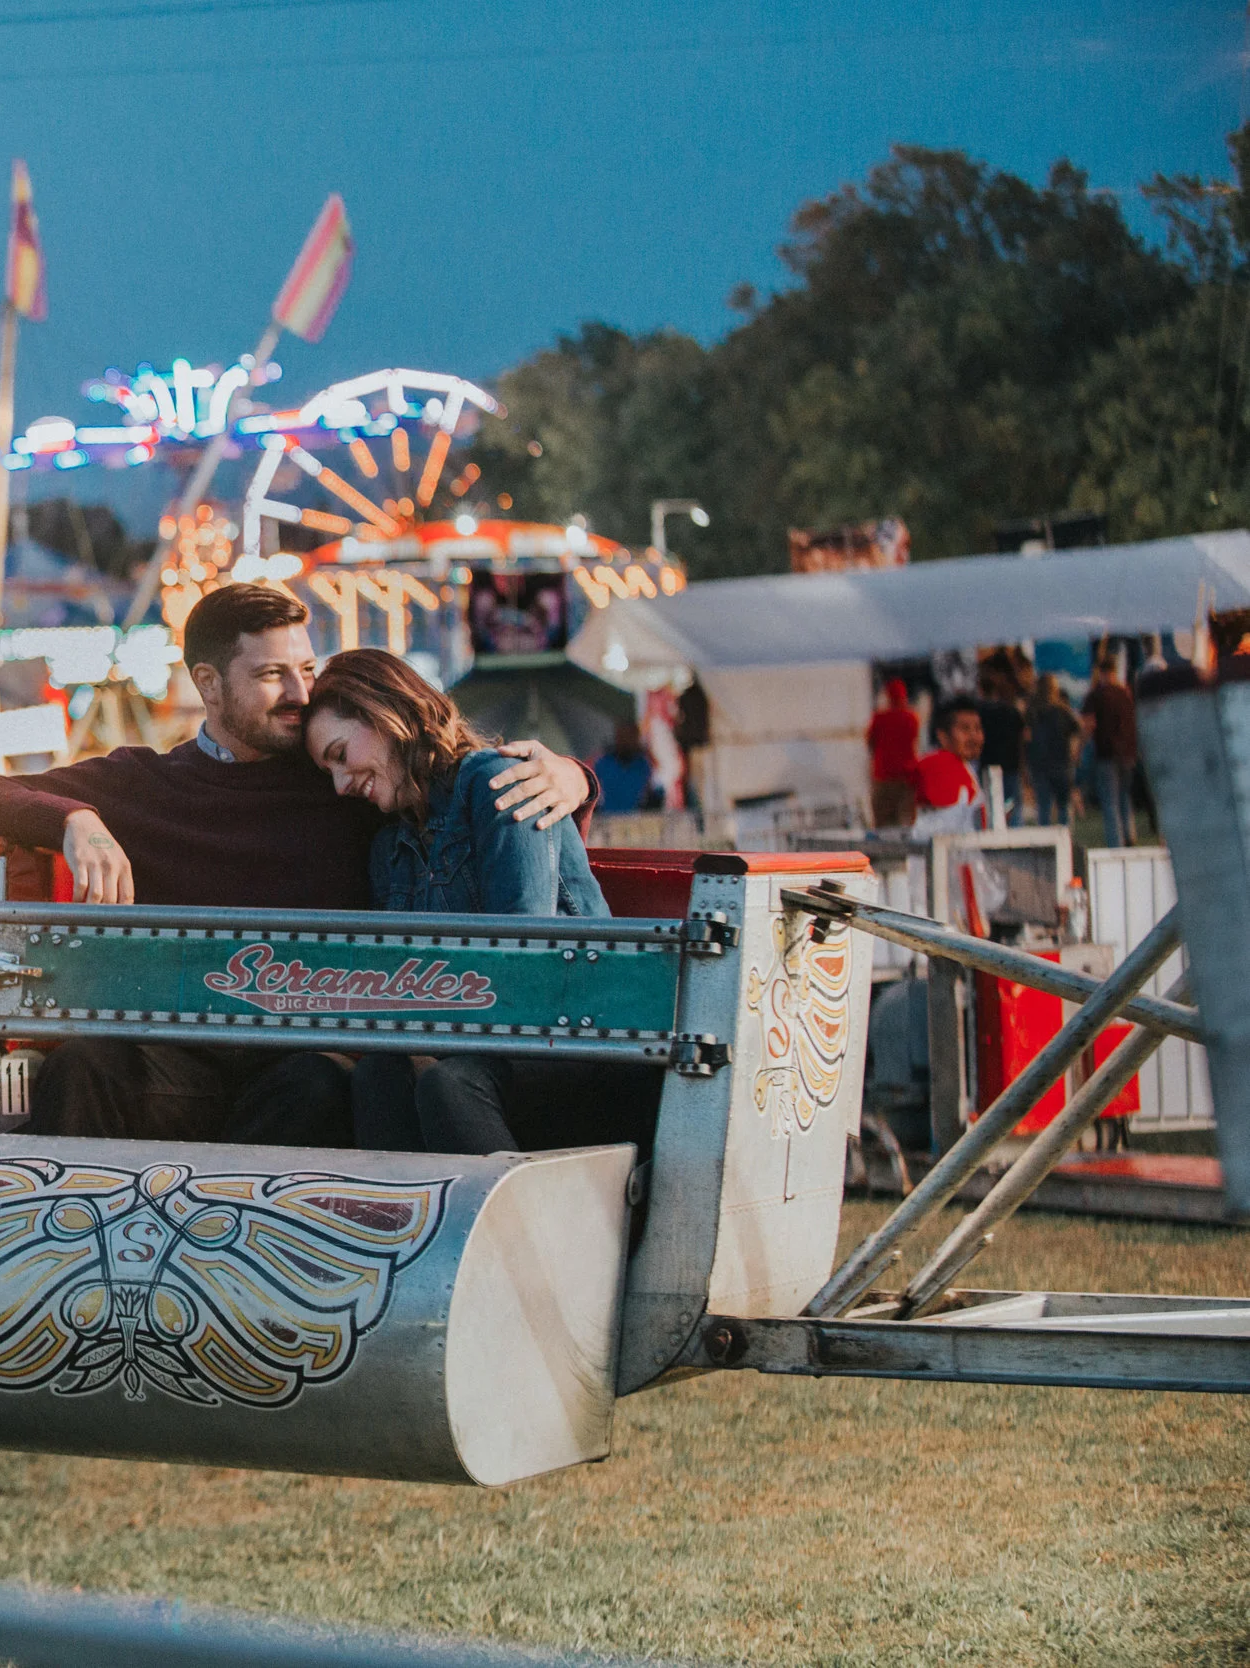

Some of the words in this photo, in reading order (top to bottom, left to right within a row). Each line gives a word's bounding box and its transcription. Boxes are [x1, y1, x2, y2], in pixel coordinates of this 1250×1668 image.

[204, 943, 497, 1004] Scrambler
[275, 995, 302, 1011] BIG
[6, 1062, 25, 1113] 11
[117, 1221, 163, 1263] S
